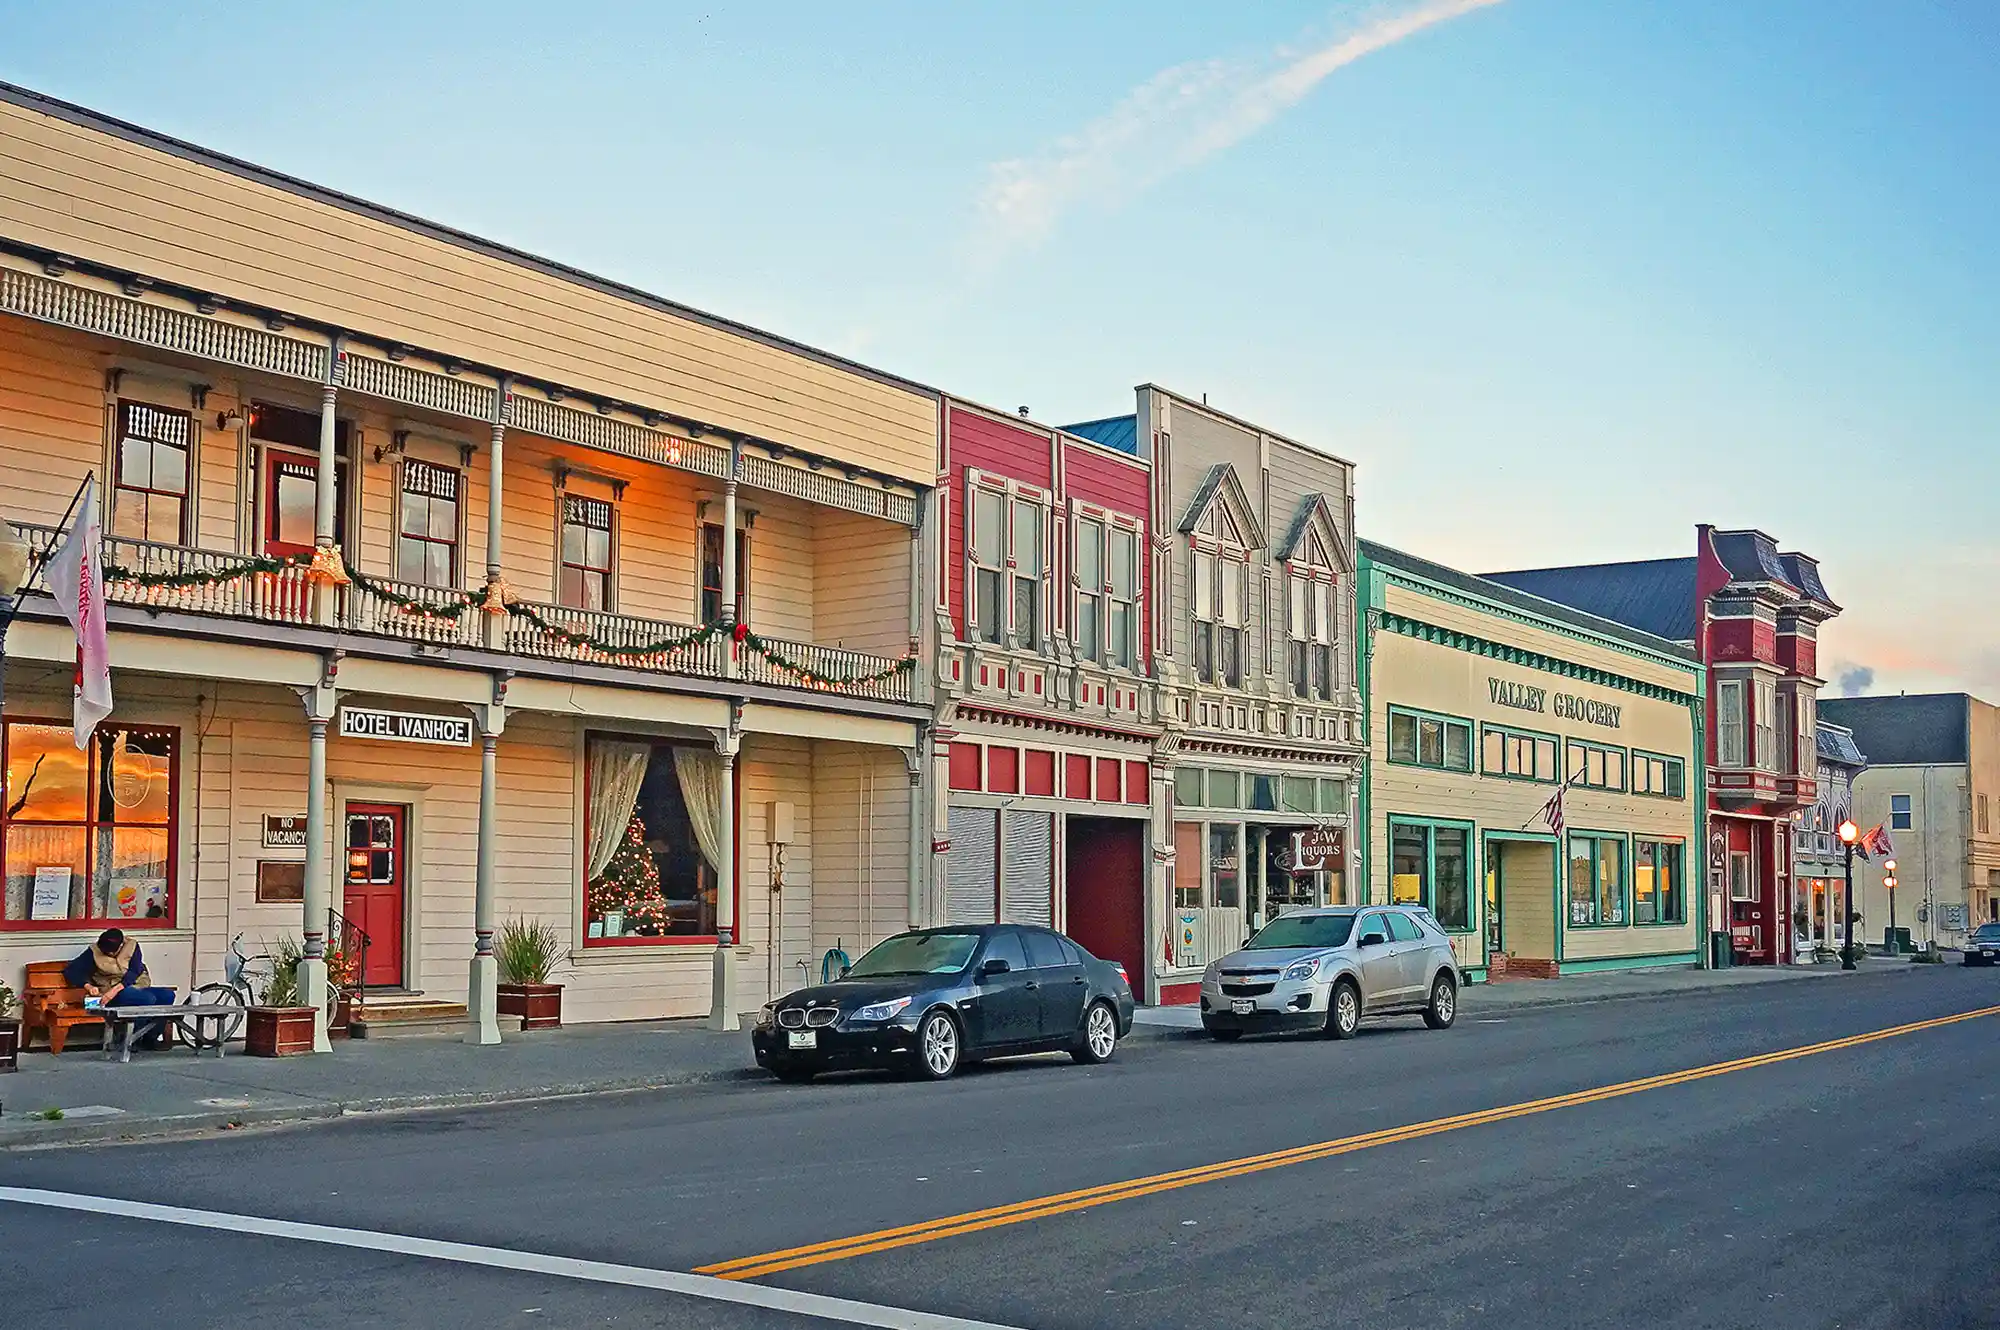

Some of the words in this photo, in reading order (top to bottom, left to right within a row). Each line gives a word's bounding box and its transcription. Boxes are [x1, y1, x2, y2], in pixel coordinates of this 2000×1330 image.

[1488, 677, 1546, 713] VALLEY
[1553, 692, 1621, 728] GROCERY
[344, 712, 395, 735] HOTEL
[281, 818, 293, 828] NO
[267, 830, 307, 844] VACANCY
[1292, 832, 1340, 871] LIQUORS
